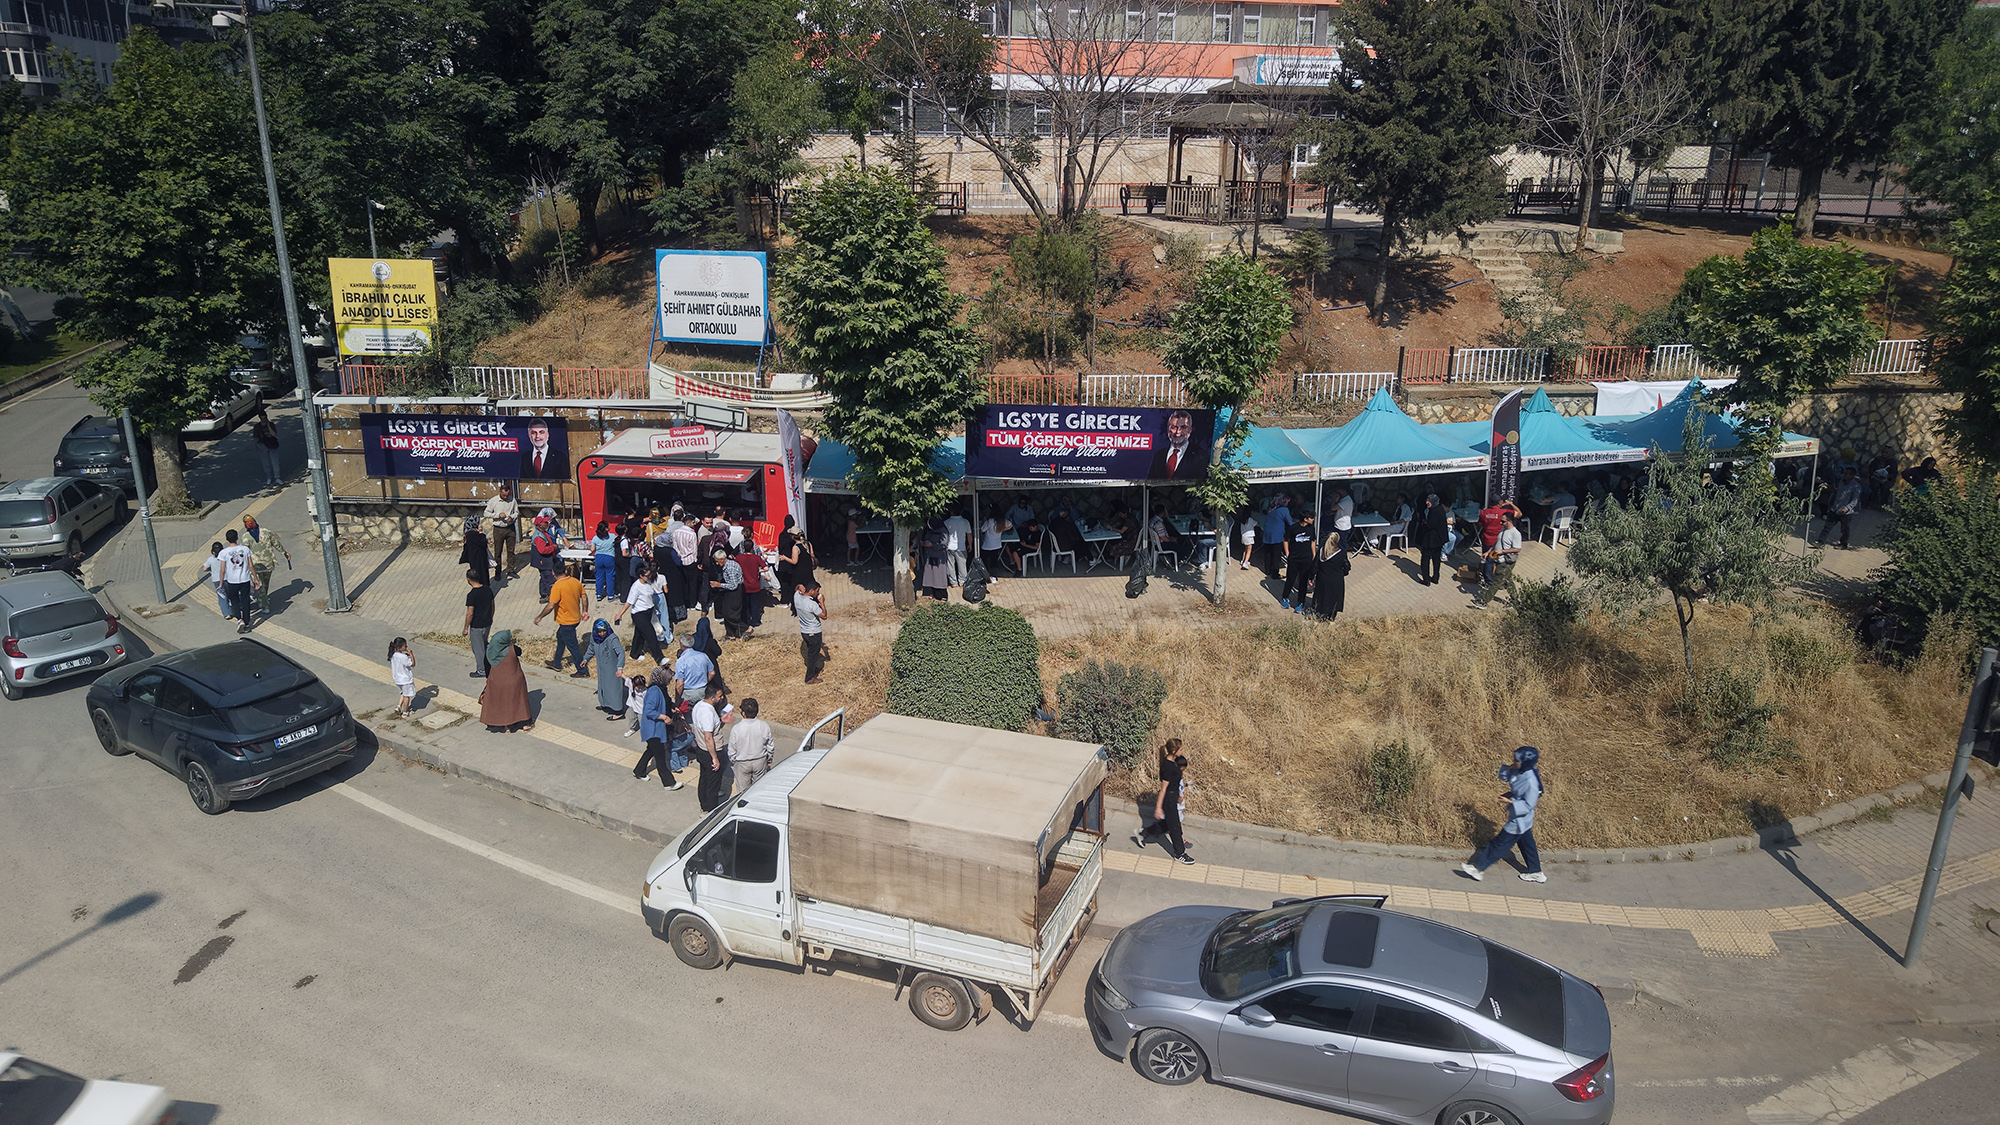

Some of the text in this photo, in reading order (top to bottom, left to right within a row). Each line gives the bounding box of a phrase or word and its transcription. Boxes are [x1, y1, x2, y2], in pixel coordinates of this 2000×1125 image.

[342, 289, 426, 307] İBRAHİM ÇALIK
[674, 290, 717, 299] KAHRAMANMARAŞ
[341, 306, 431, 319] ANADOLU LİSES
[664, 300, 761, 317] ŞEHİT AHMET GÜLBAHAR
[689, 322, 737, 335] ORTAOKULU
[388, 418, 507, 436] LGS'YE GİRECEK
[999, 411, 1141, 430] LGS'YE GİRECEK
[383, 436, 517, 450] TÜM ÖĞRENCİLERİMİZE
[657, 437, 709, 449] karavanı
[989, 431, 1150, 448] TÜM ÖĞRENCİLERİMİZE
[410, 447, 491, 459] Başarılar Dilerim
[1020, 445, 1117, 458] Başarılar Dilerim
[1528, 456, 1567, 466] Kahramanmaraş
[1567, 453, 1594, 463] Büyükşehir
[1595, 452, 1619, 461] Belediyesi
[1358, 465, 1398, 475] Kahramanmaraş
[1399, 462, 1427, 473] Büyükşehir
[280, 736, 287, 745] 46
